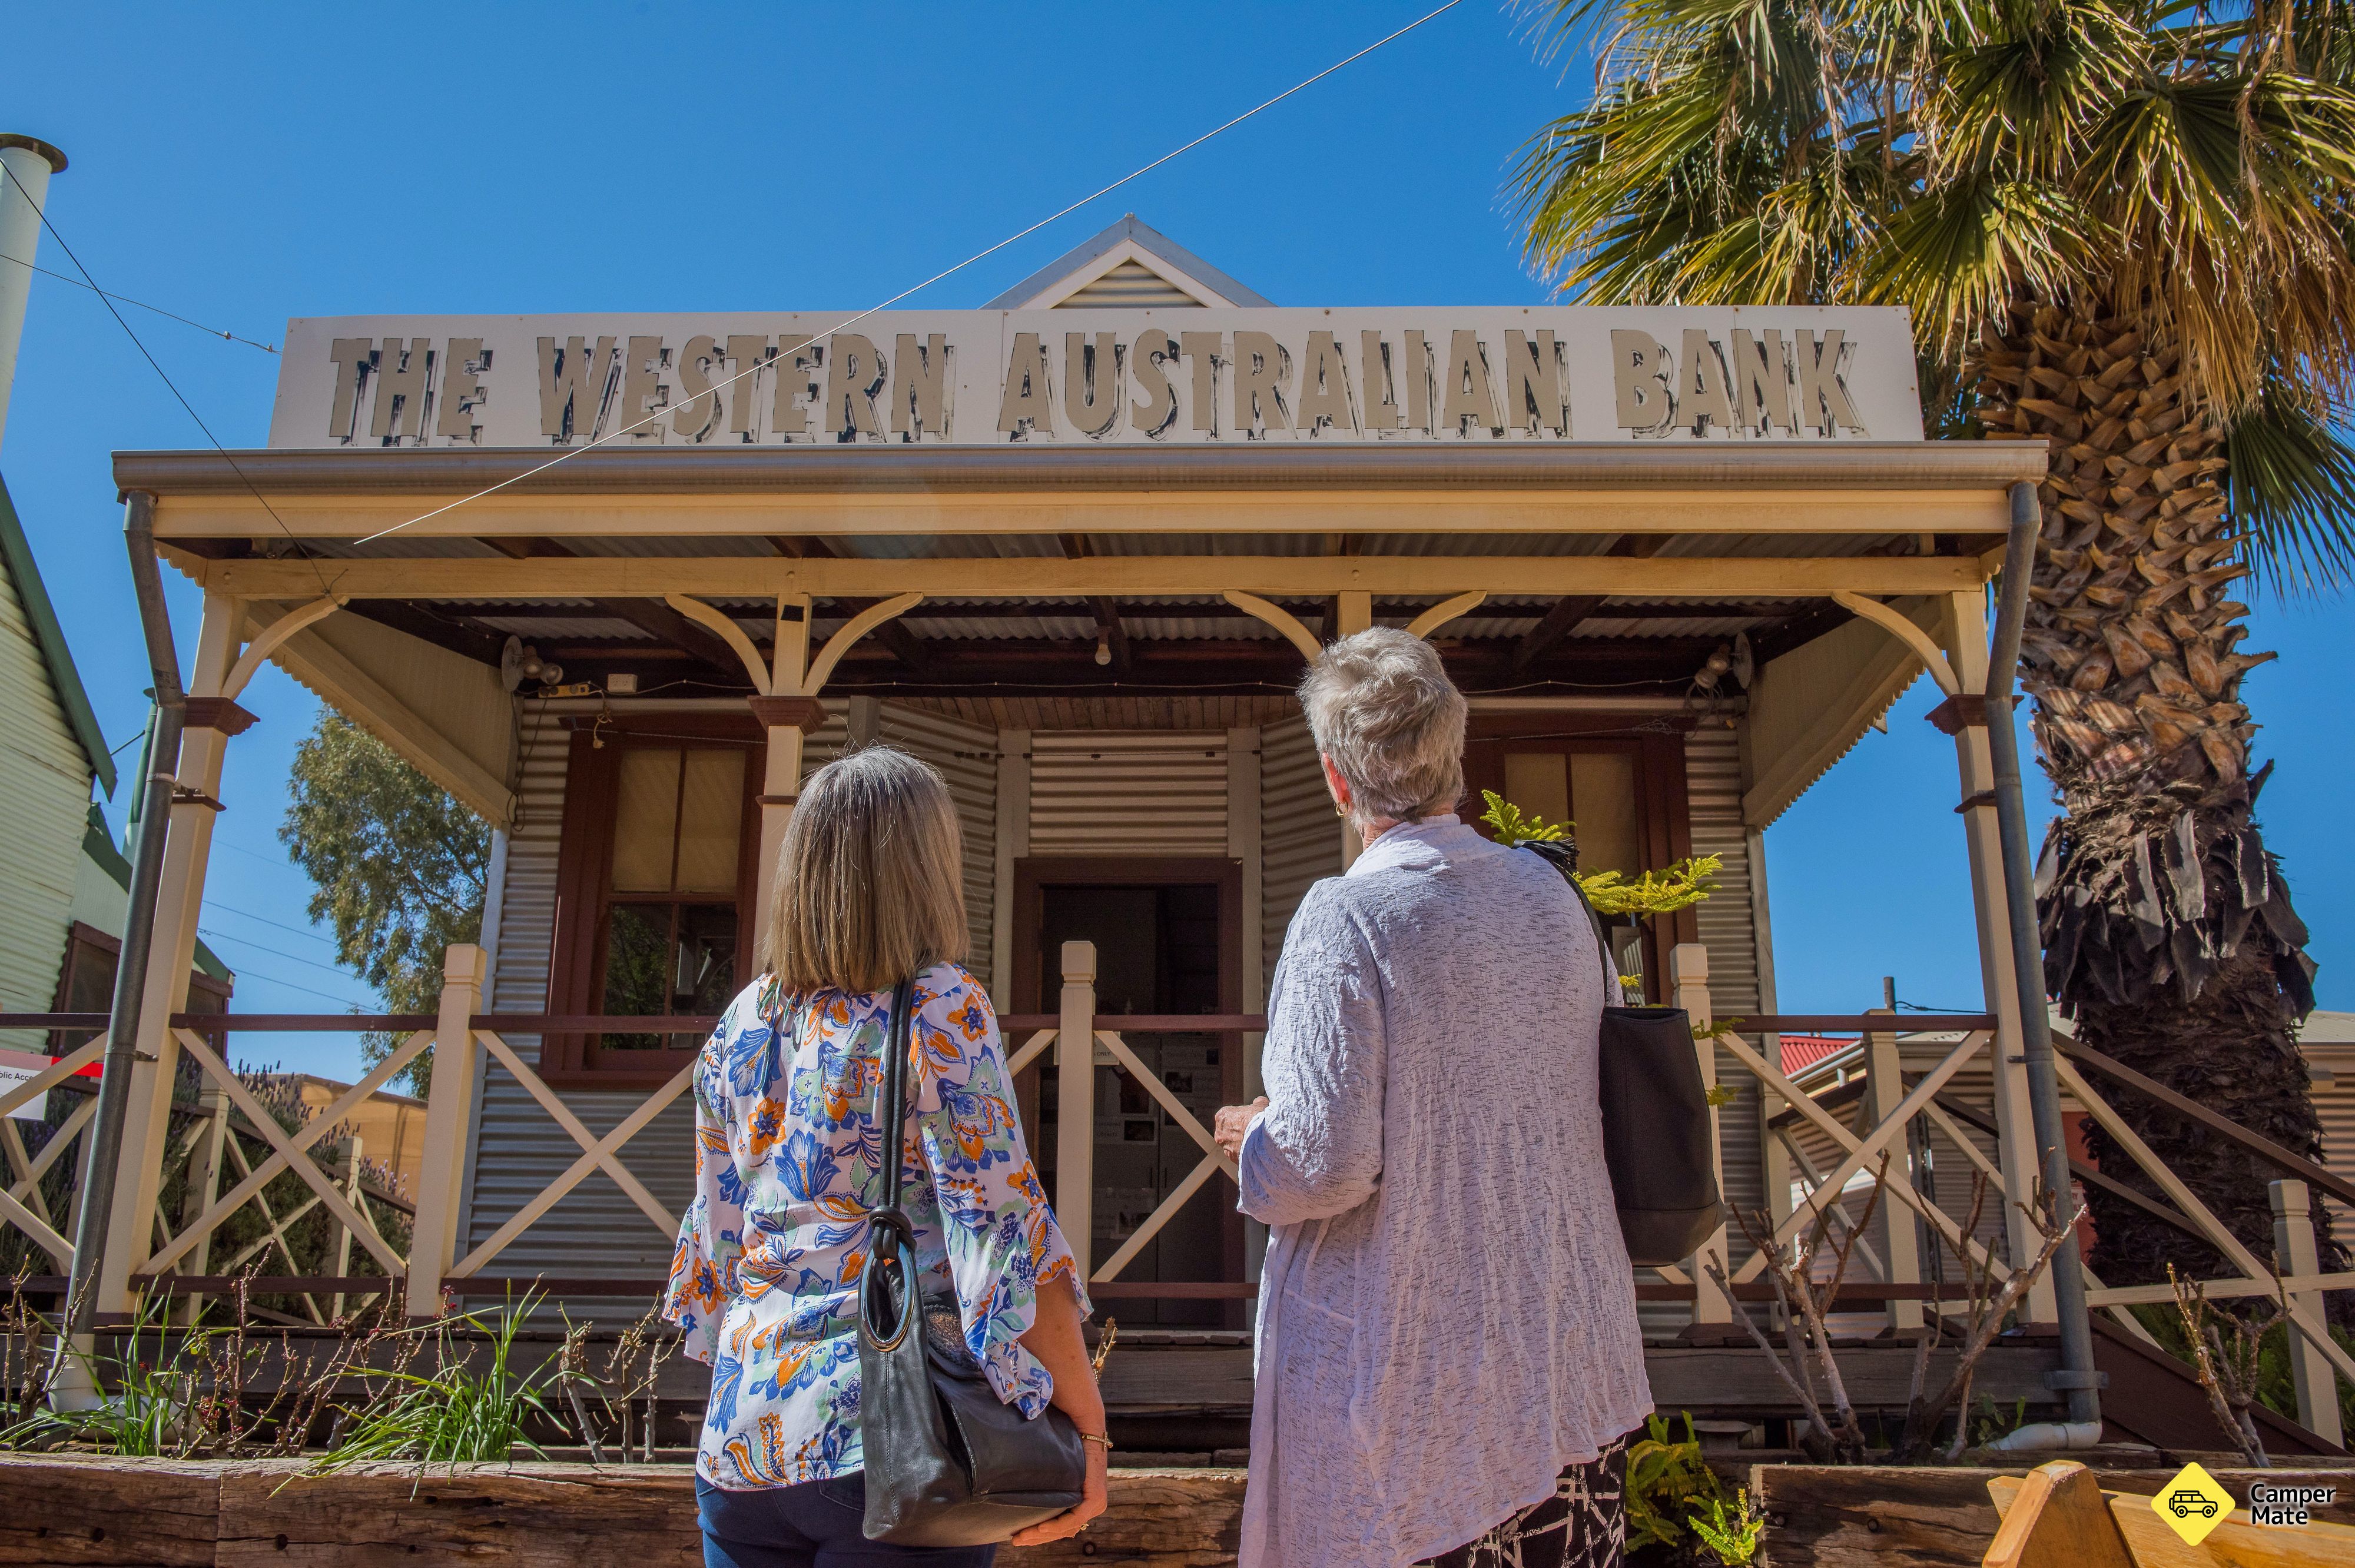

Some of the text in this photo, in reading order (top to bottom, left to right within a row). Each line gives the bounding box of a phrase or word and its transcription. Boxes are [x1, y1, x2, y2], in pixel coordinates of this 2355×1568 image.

[329, 328, 1872, 447] THE WESTERN AUSTRALIAN BANK
